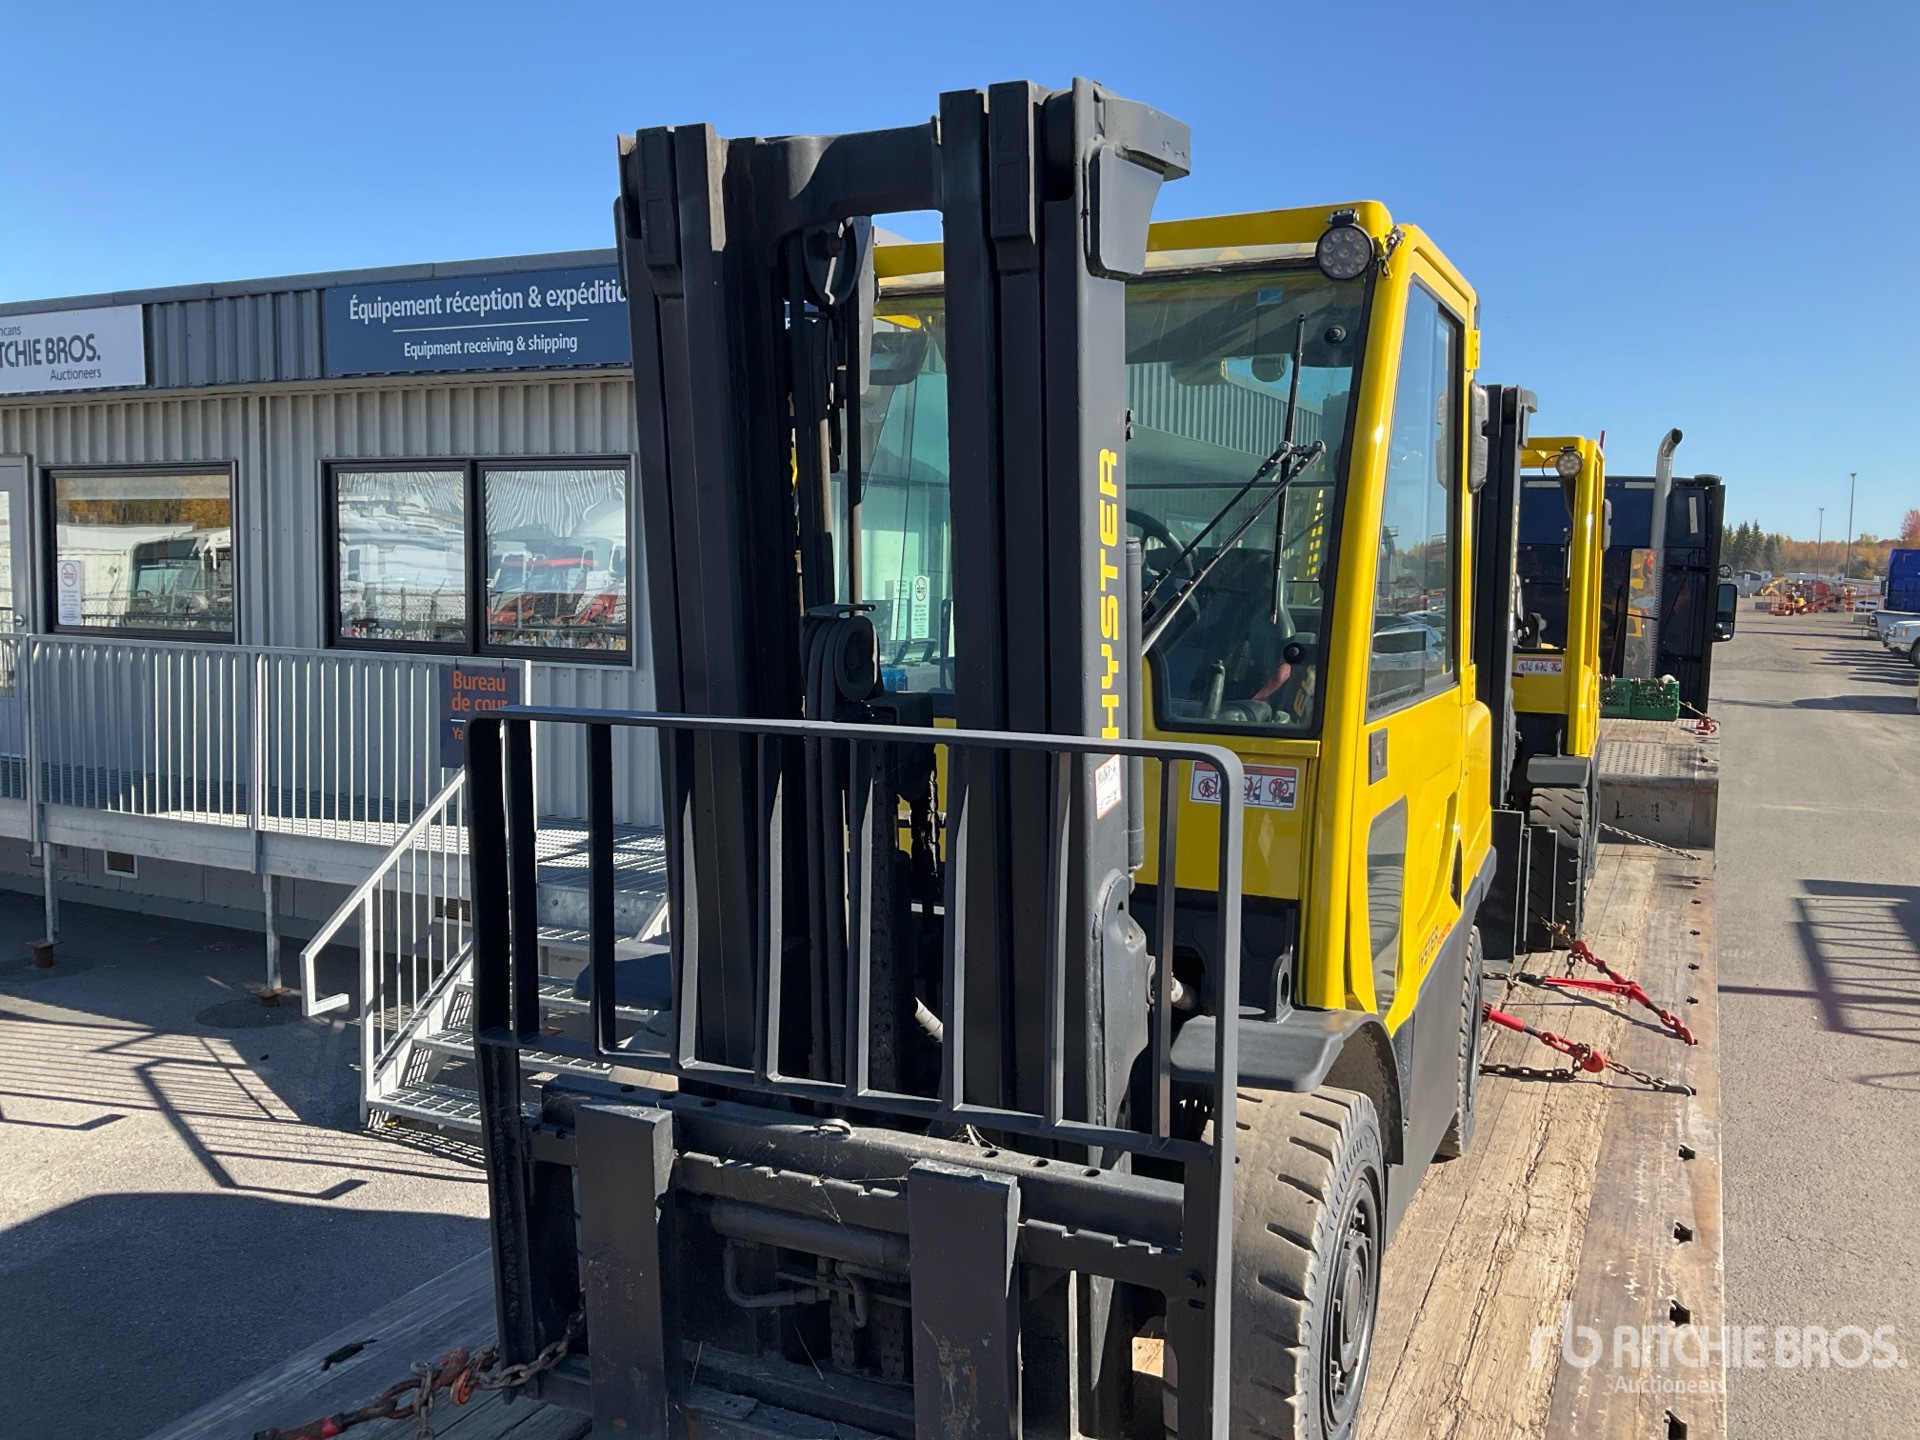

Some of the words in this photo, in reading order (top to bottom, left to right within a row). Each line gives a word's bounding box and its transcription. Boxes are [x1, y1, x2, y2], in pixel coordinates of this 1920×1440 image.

[350, 294, 442, 324] Équipement
[446, 287, 523, 317] réception
[528, 285, 541, 308] &
[45, 333, 101, 365] BROS.
[404, 340, 462, 360] Equipment
[464, 336, 514, 355] receiving
[516, 336, 526, 351] &
[528, 333, 577, 353] shipping
[50, 368, 102, 381] Auctioneers
[1099, 448, 1119, 739] HYSTER
[452, 670, 506, 691] Bureau
[451, 692, 470, 712] de
